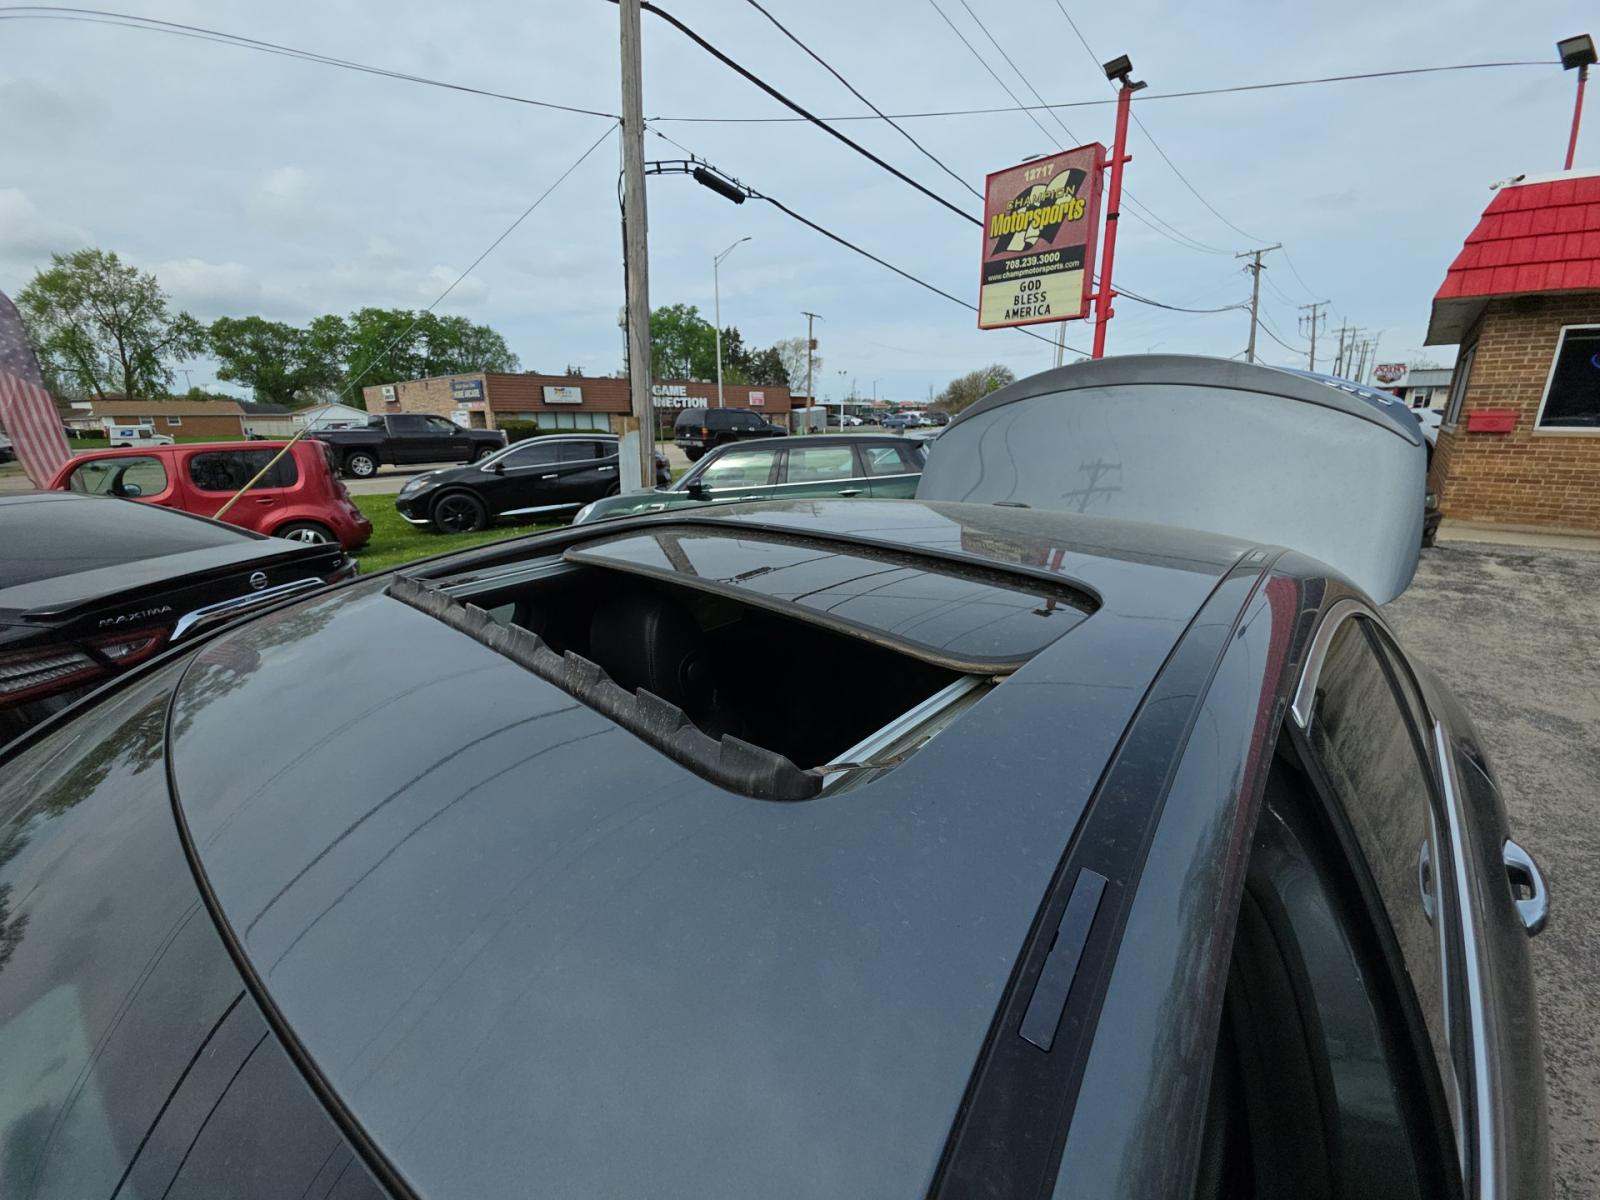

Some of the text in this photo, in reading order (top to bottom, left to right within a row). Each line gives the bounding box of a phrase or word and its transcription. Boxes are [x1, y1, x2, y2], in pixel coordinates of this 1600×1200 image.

[1025, 164, 1054, 181] 12717
[990, 198, 1086, 239] Motorsports
[1005, 252, 1060, 269] 708.239.3000
[988, 260, 1080, 281] www.champmotorsports.com
[1020, 280, 1042, 293] GOD
[1013, 291, 1047, 306] BLESS
[1005, 304, 1051, 320] AMERICA
[99, 605, 172, 626] MAXIMA
